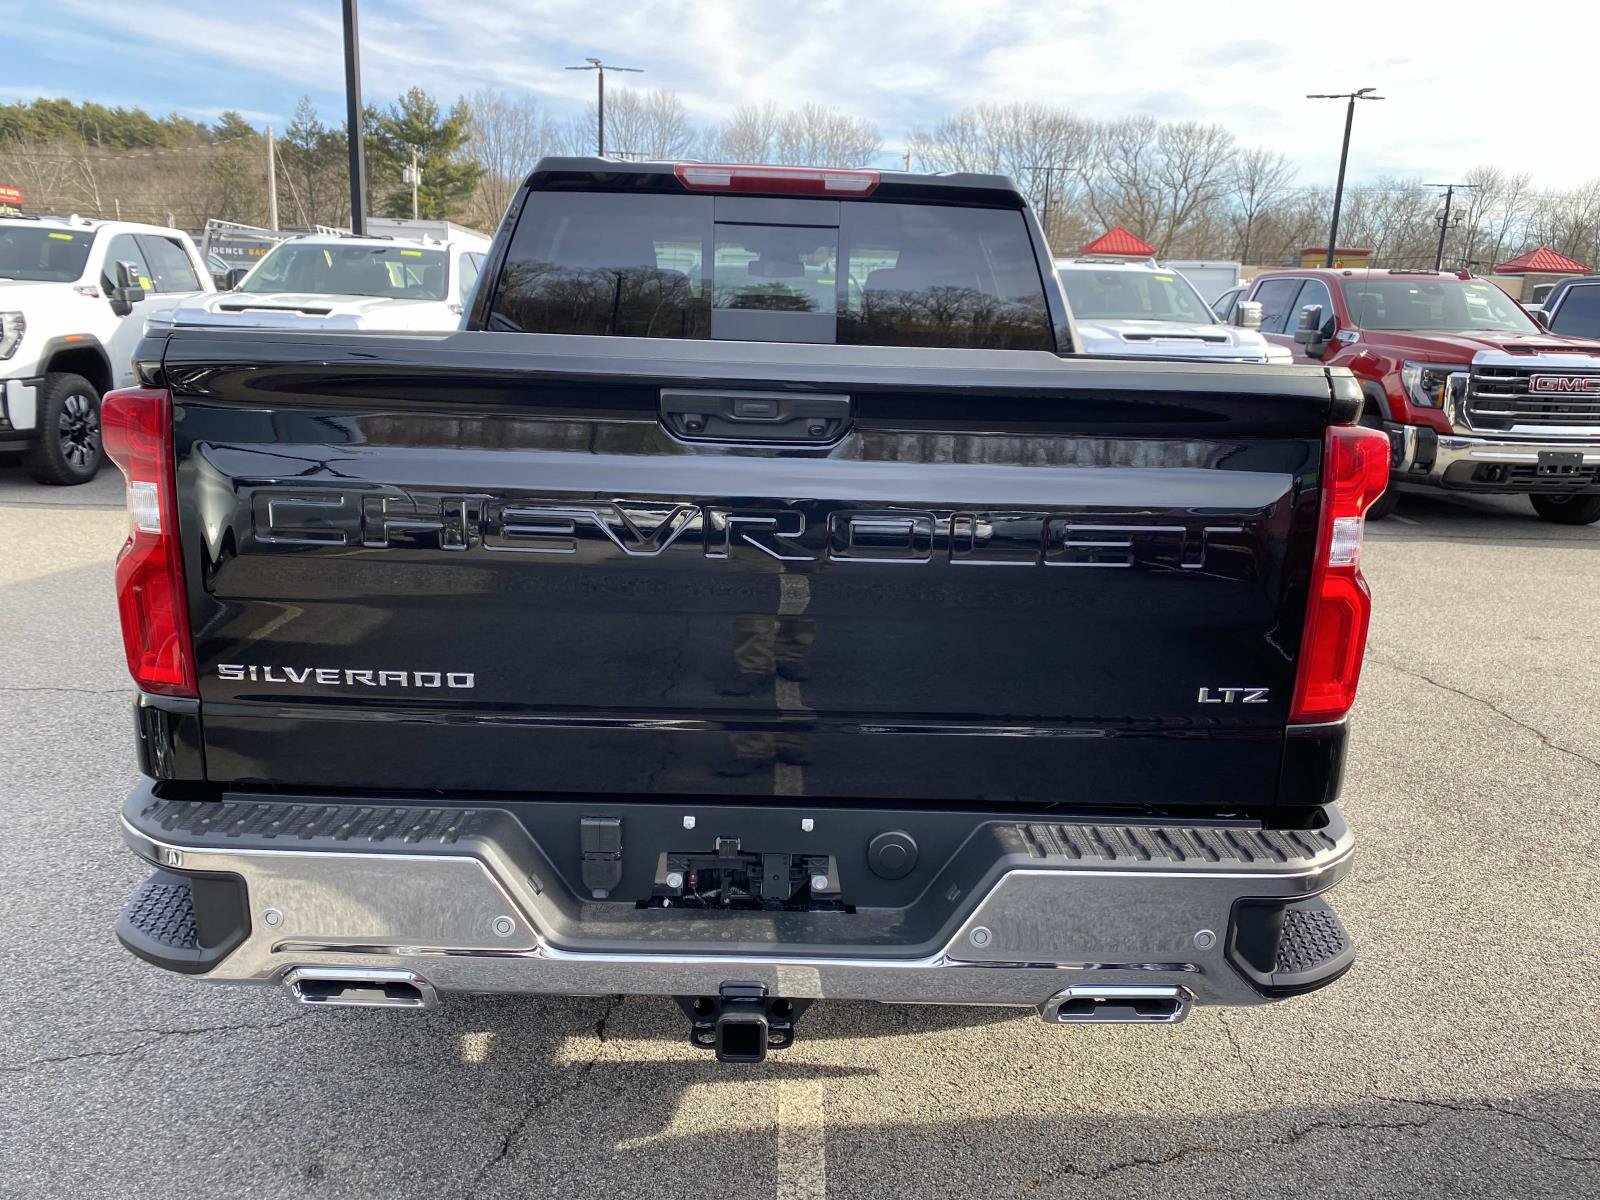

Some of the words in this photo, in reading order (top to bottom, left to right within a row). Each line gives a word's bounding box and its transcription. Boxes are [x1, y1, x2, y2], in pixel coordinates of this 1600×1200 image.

[1536, 377, 1600, 392] GMC
[251, 490, 1246, 569] CHEVROLET
[217, 663, 476, 689] SILVERADO
[1197, 687, 1270, 704] LTZ
